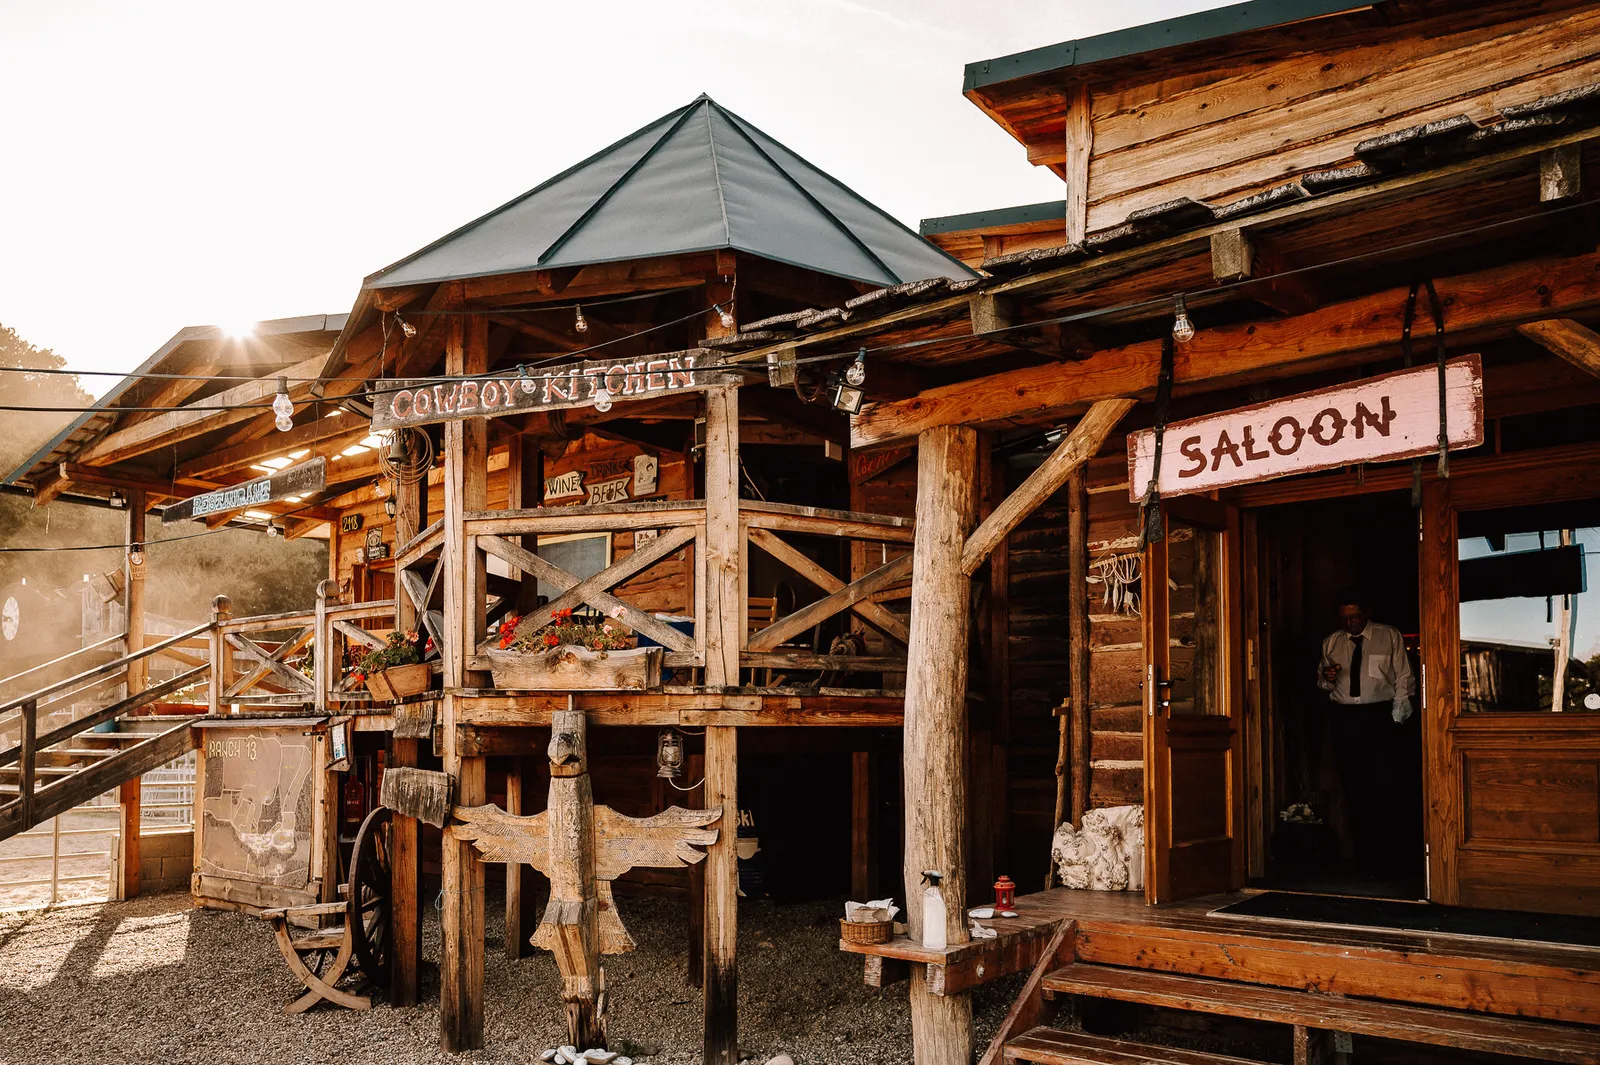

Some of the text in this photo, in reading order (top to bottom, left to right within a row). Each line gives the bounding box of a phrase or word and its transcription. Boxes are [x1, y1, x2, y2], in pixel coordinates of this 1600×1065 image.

[390, 356, 695, 419] COWBOY KITCHEN
[1177, 395, 1397, 479] SALOON
[192, 479, 271, 517] RESTAURANT
[547, 475, 578, 496] WINE
[592, 480, 625, 505] BEER
[209, 740, 257, 761] RANCH 13
